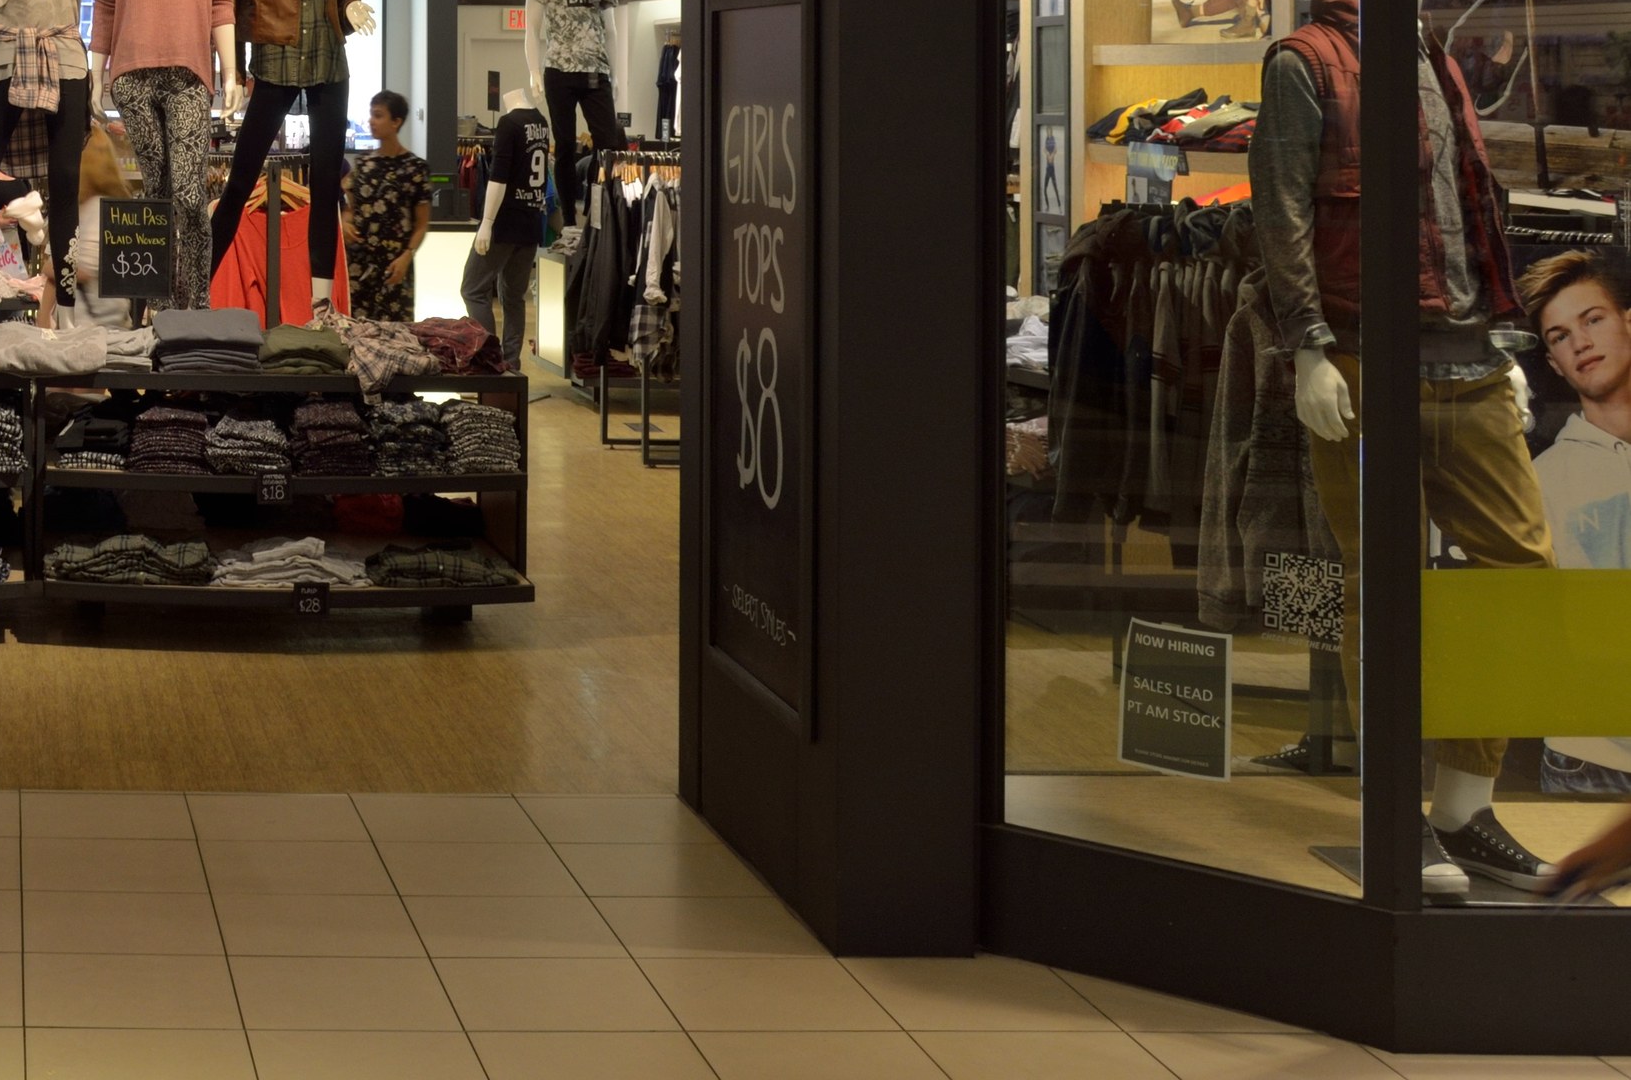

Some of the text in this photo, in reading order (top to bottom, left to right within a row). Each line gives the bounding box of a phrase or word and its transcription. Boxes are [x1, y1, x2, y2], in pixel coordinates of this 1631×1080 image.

[509, 9, 526, 28] EXI
[529, 149, 545, 188] 9
[724, 102, 796, 215] GIRLS
[112, 250, 159, 279] $32
[733, 222, 785, 314] TOPS
[736, 327, 784, 510] $8
[300, 597, 321, 612] $28
[732, 583, 758, 628] SELECT
[1135, 633, 1215, 657] NOW HIRING
[1133, 676, 1213, 702] SALES LEAD
[1127, 700, 1220, 728] PT AM STOCK
